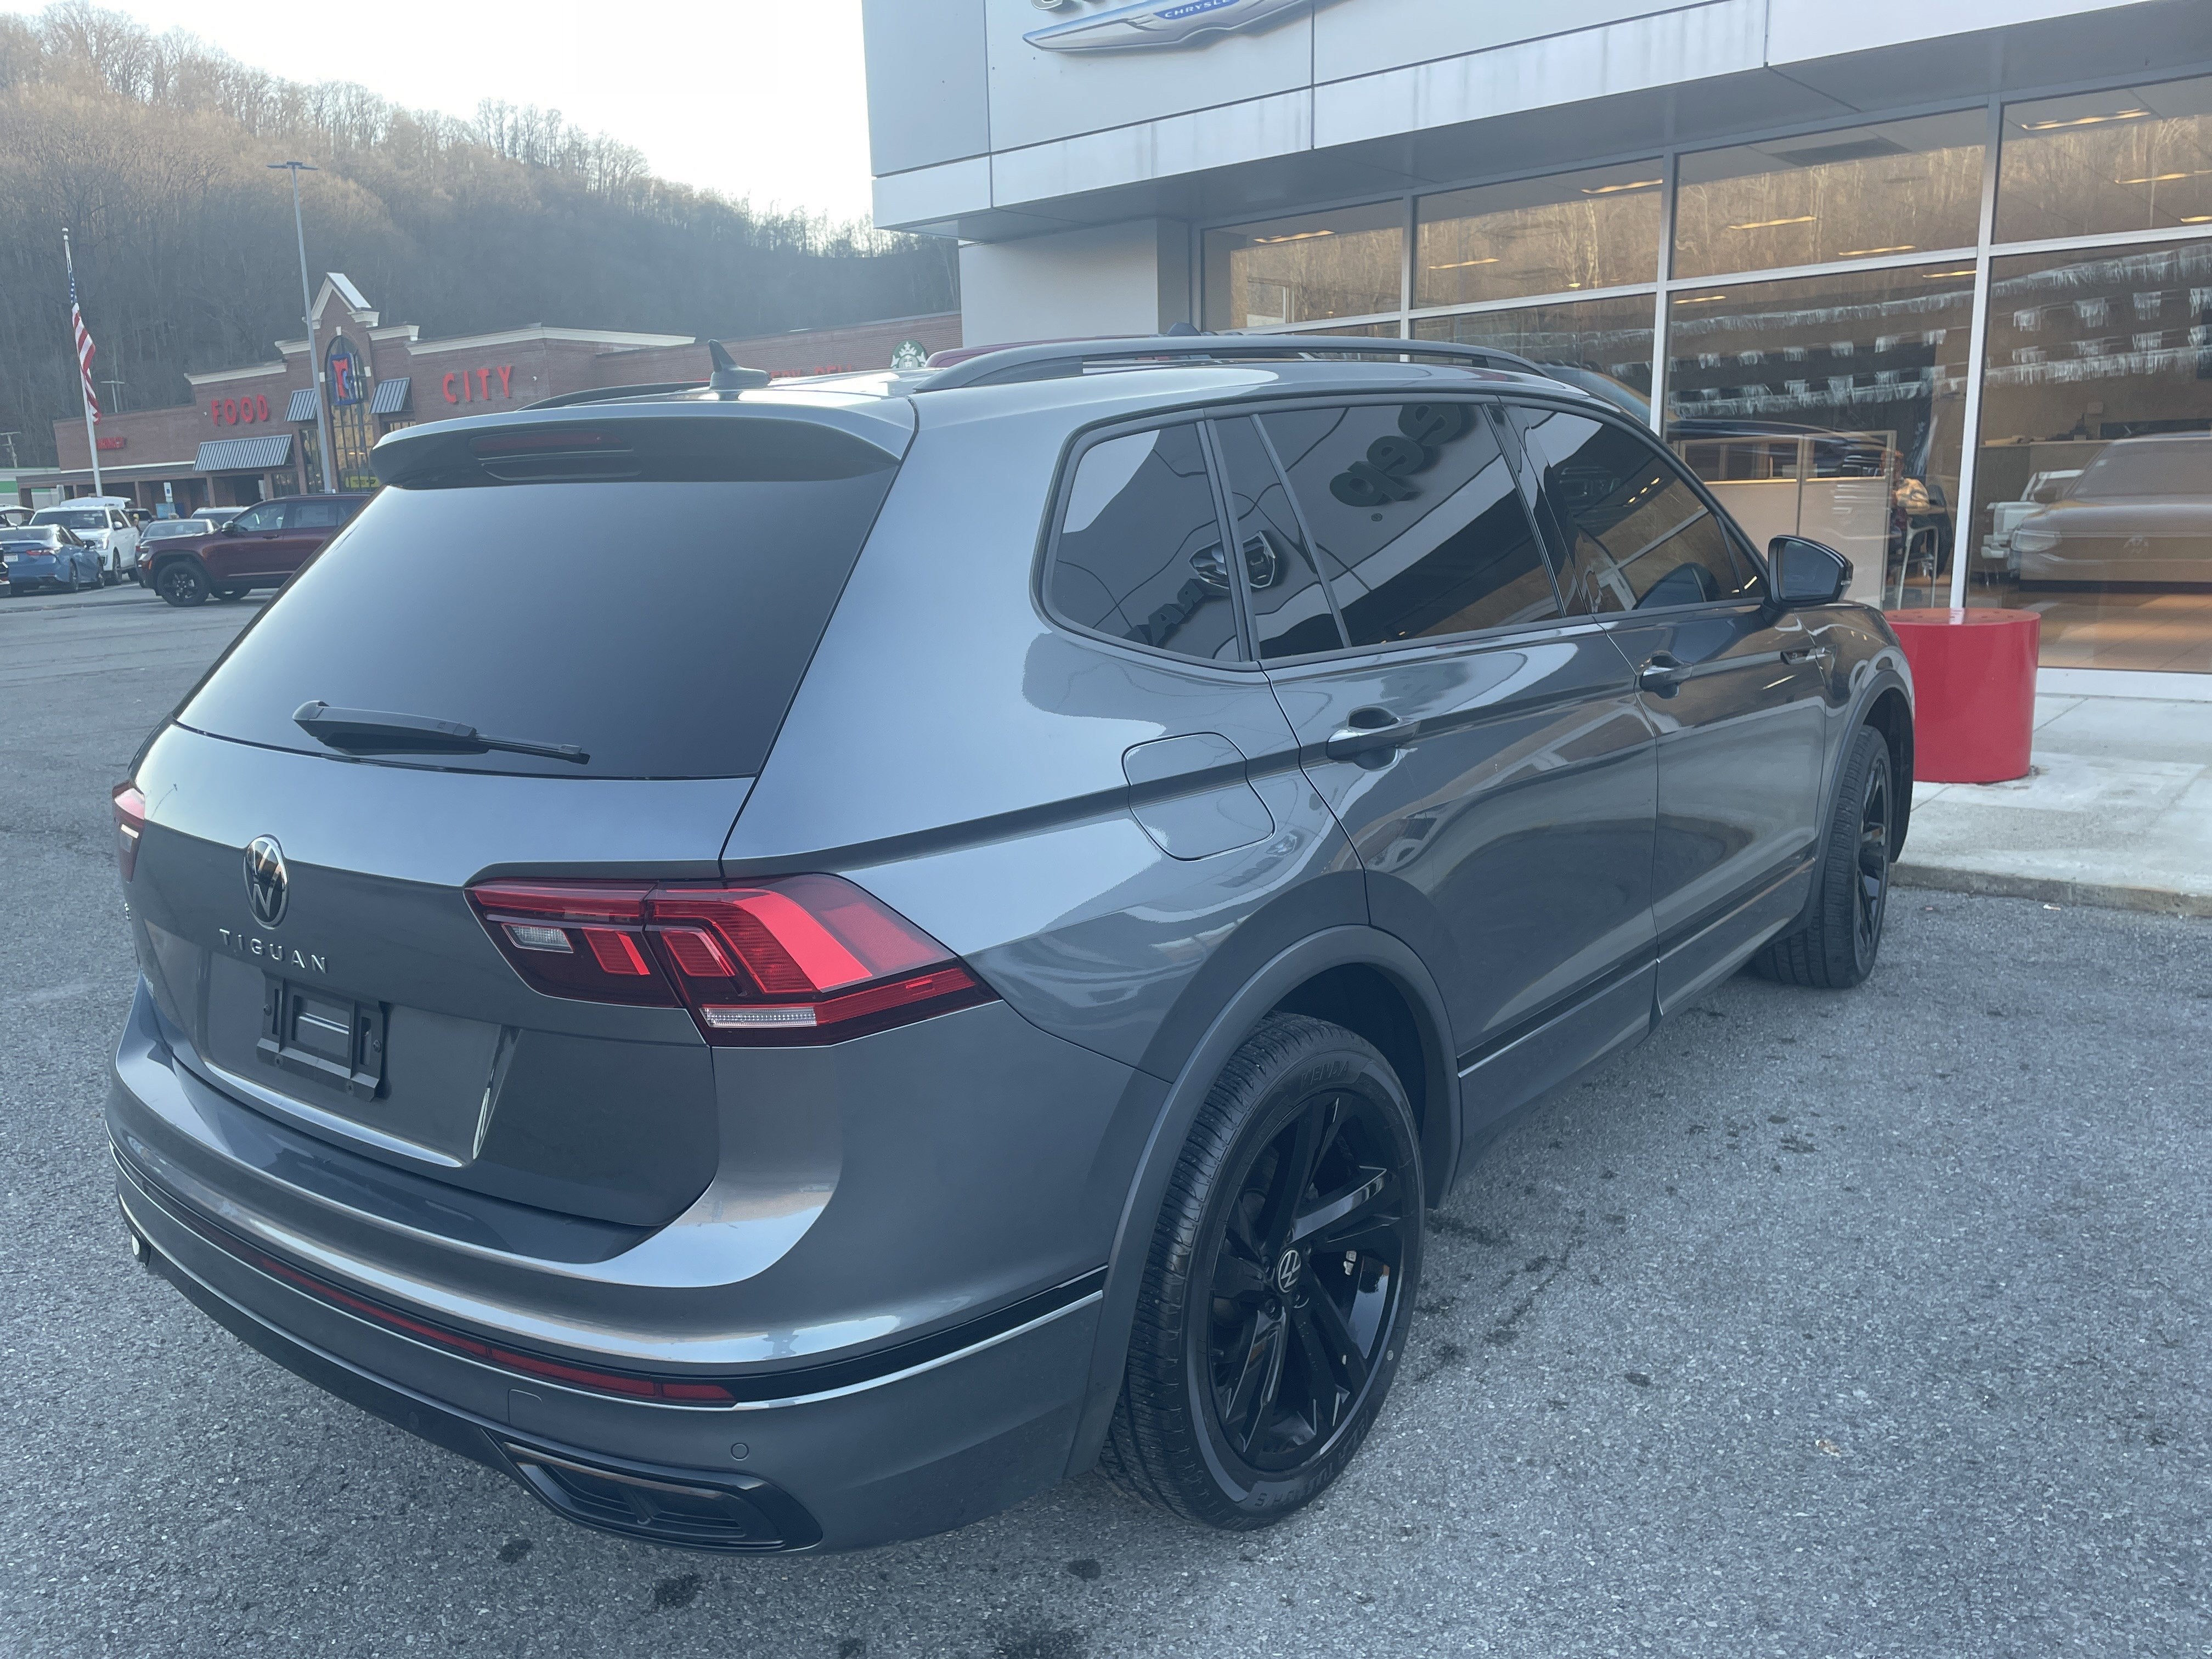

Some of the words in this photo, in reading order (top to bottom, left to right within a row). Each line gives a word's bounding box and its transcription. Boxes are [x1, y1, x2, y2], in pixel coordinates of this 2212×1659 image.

[1165, 0, 1232, 18] CHRYSL
[211, 393, 268, 427] FOOD
[442, 365, 512, 404] CITY
[219, 928, 328, 974] TIGUAN
